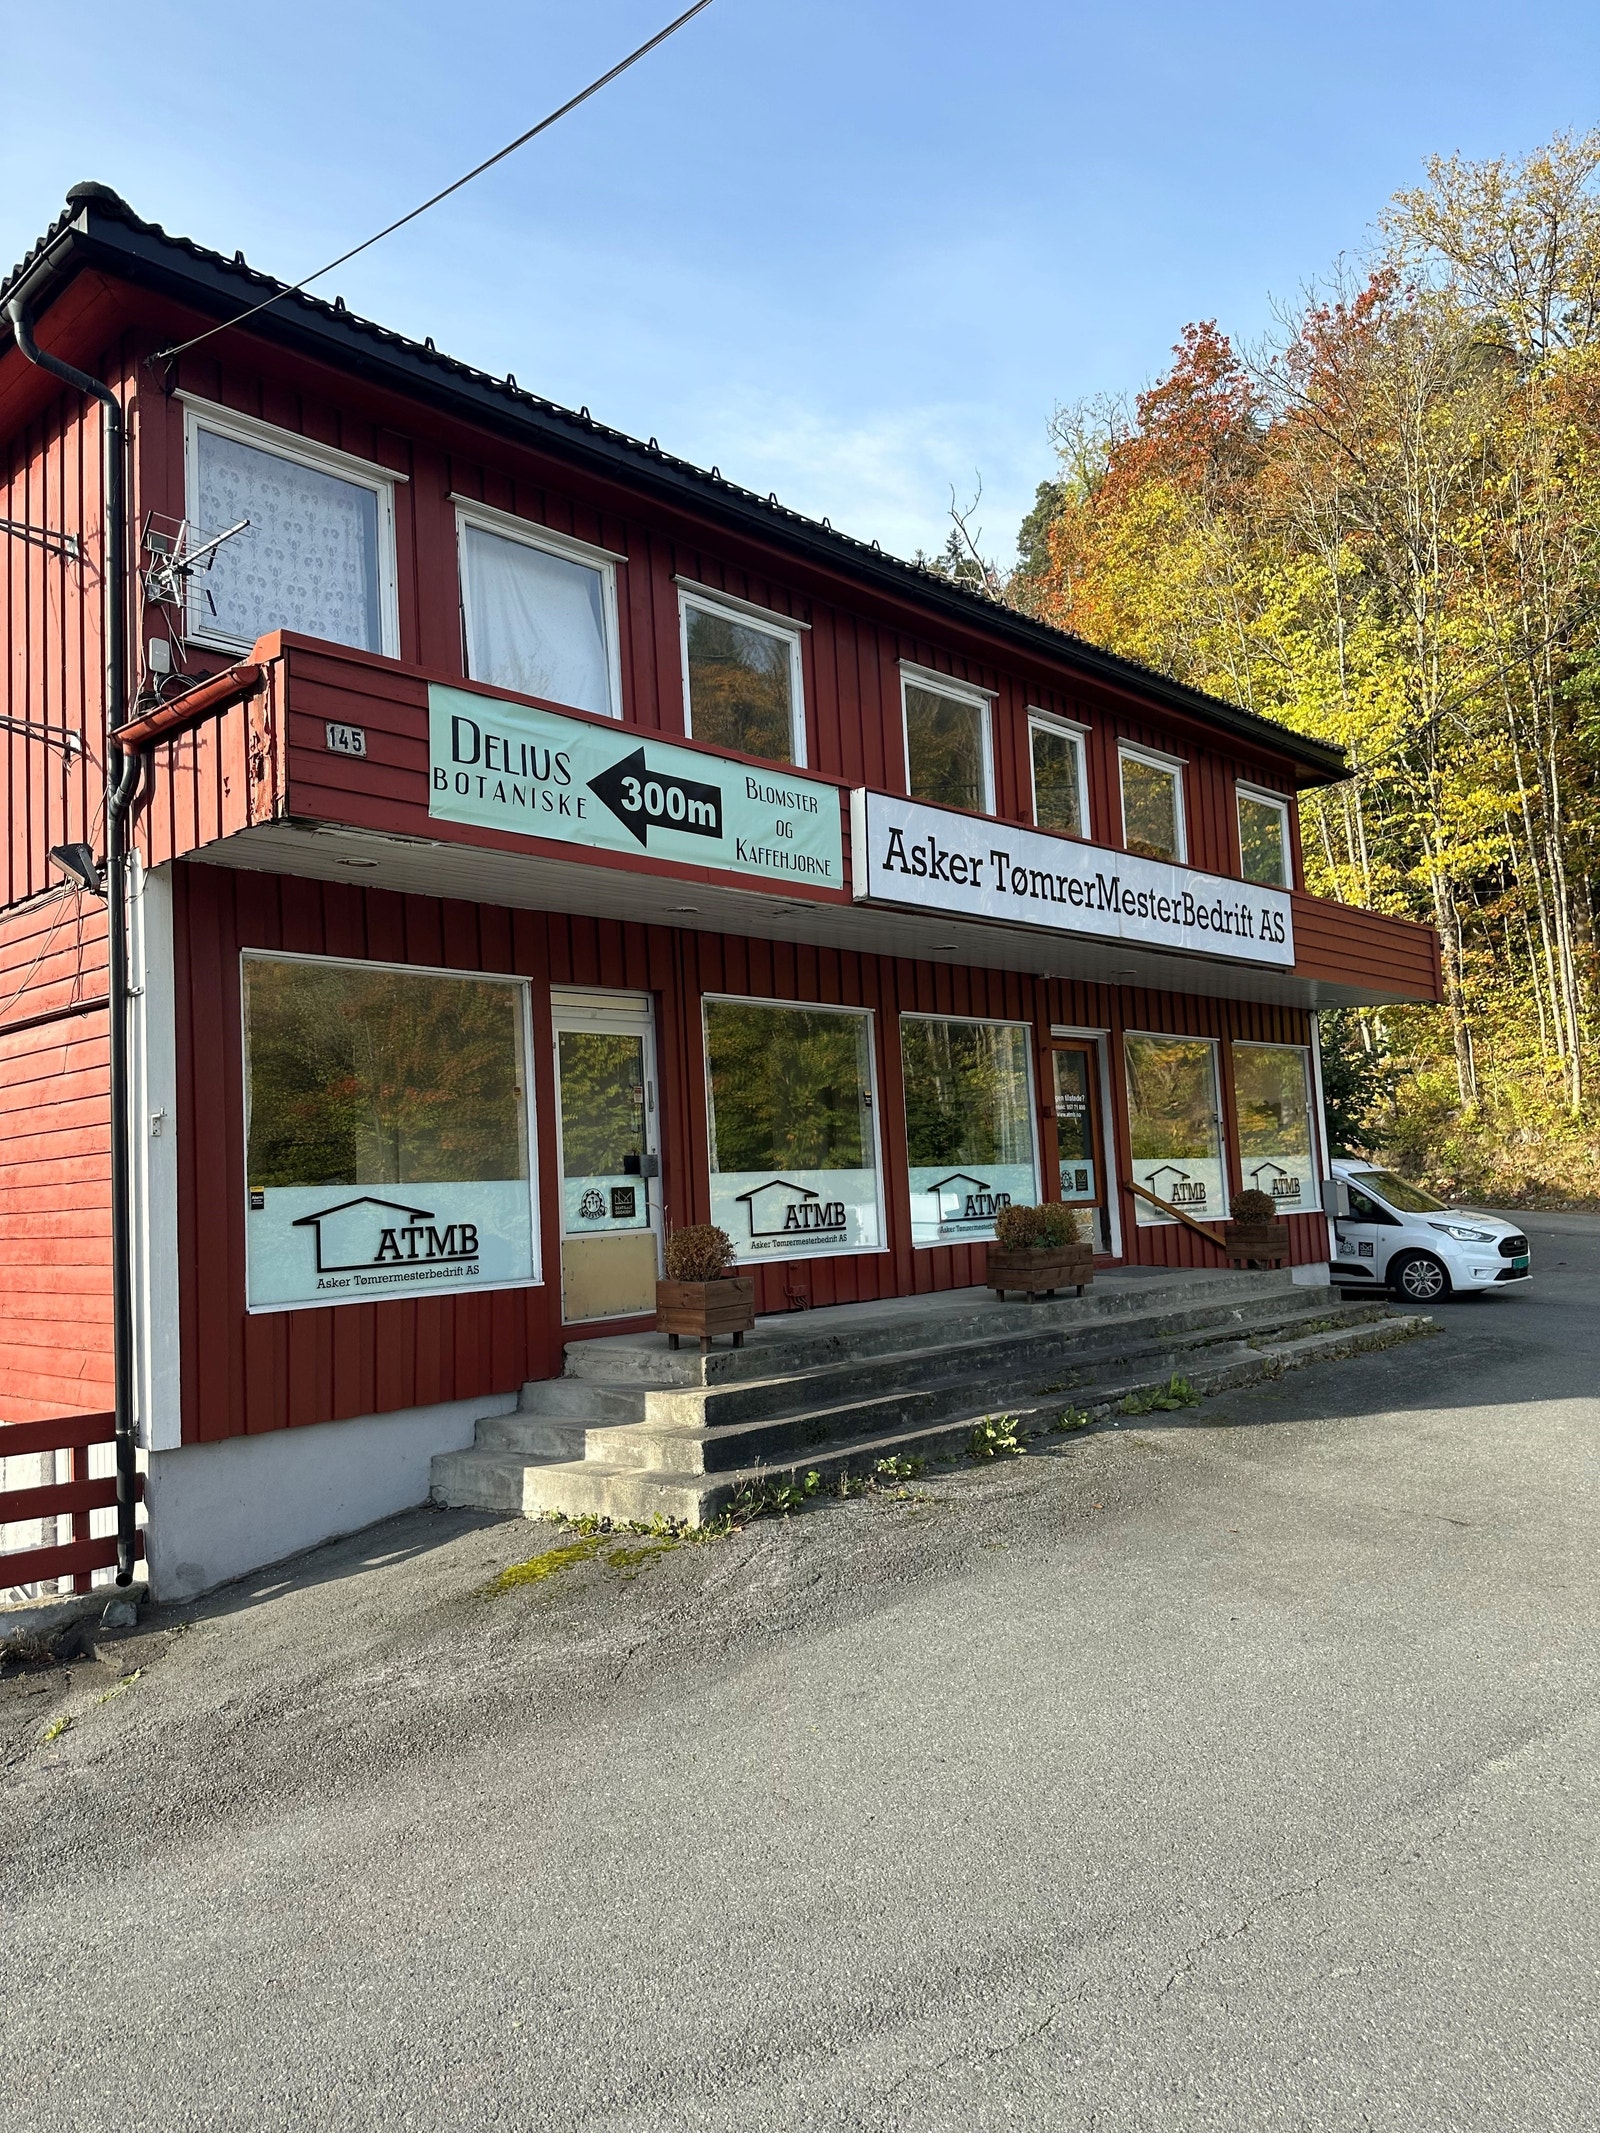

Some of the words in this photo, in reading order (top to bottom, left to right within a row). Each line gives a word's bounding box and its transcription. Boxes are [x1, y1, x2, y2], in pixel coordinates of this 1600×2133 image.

[328, 724, 363, 753] 145
[451, 715, 571, 787] DELIUS
[433, 766, 588, 820] BOTANISKE
[620, 775, 716, 828] 300m
[746, 777, 818, 815] BLOMSTER
[776, 819, 793, 840] OG
[736, 837, 831, 877] KAFFEHJØRNE
[882, 827, 984, 887] Asker
[990, 849, 1254, 939] TømrerMesterBedrift
[1259, 908, 1286, 944] AS
[1172, 1182, 1206, 1201] ATMB
[1270, 1177, 1301, 1195] ATMB
[784, 1202, 847, 1229] ATMB
[964, 1193, 1012, 1217] ATMB
[374, 1224, 479, 1261] ATMB
[751, 1241, 771, 1249] Asker
[839, 1234, 848, 1242] AS
[317, 1278, 351, 1289] Asker
[353, 1267, 463, 1286] Tømrermesterbedrift
[465, 1265, 480, 1275] AS
